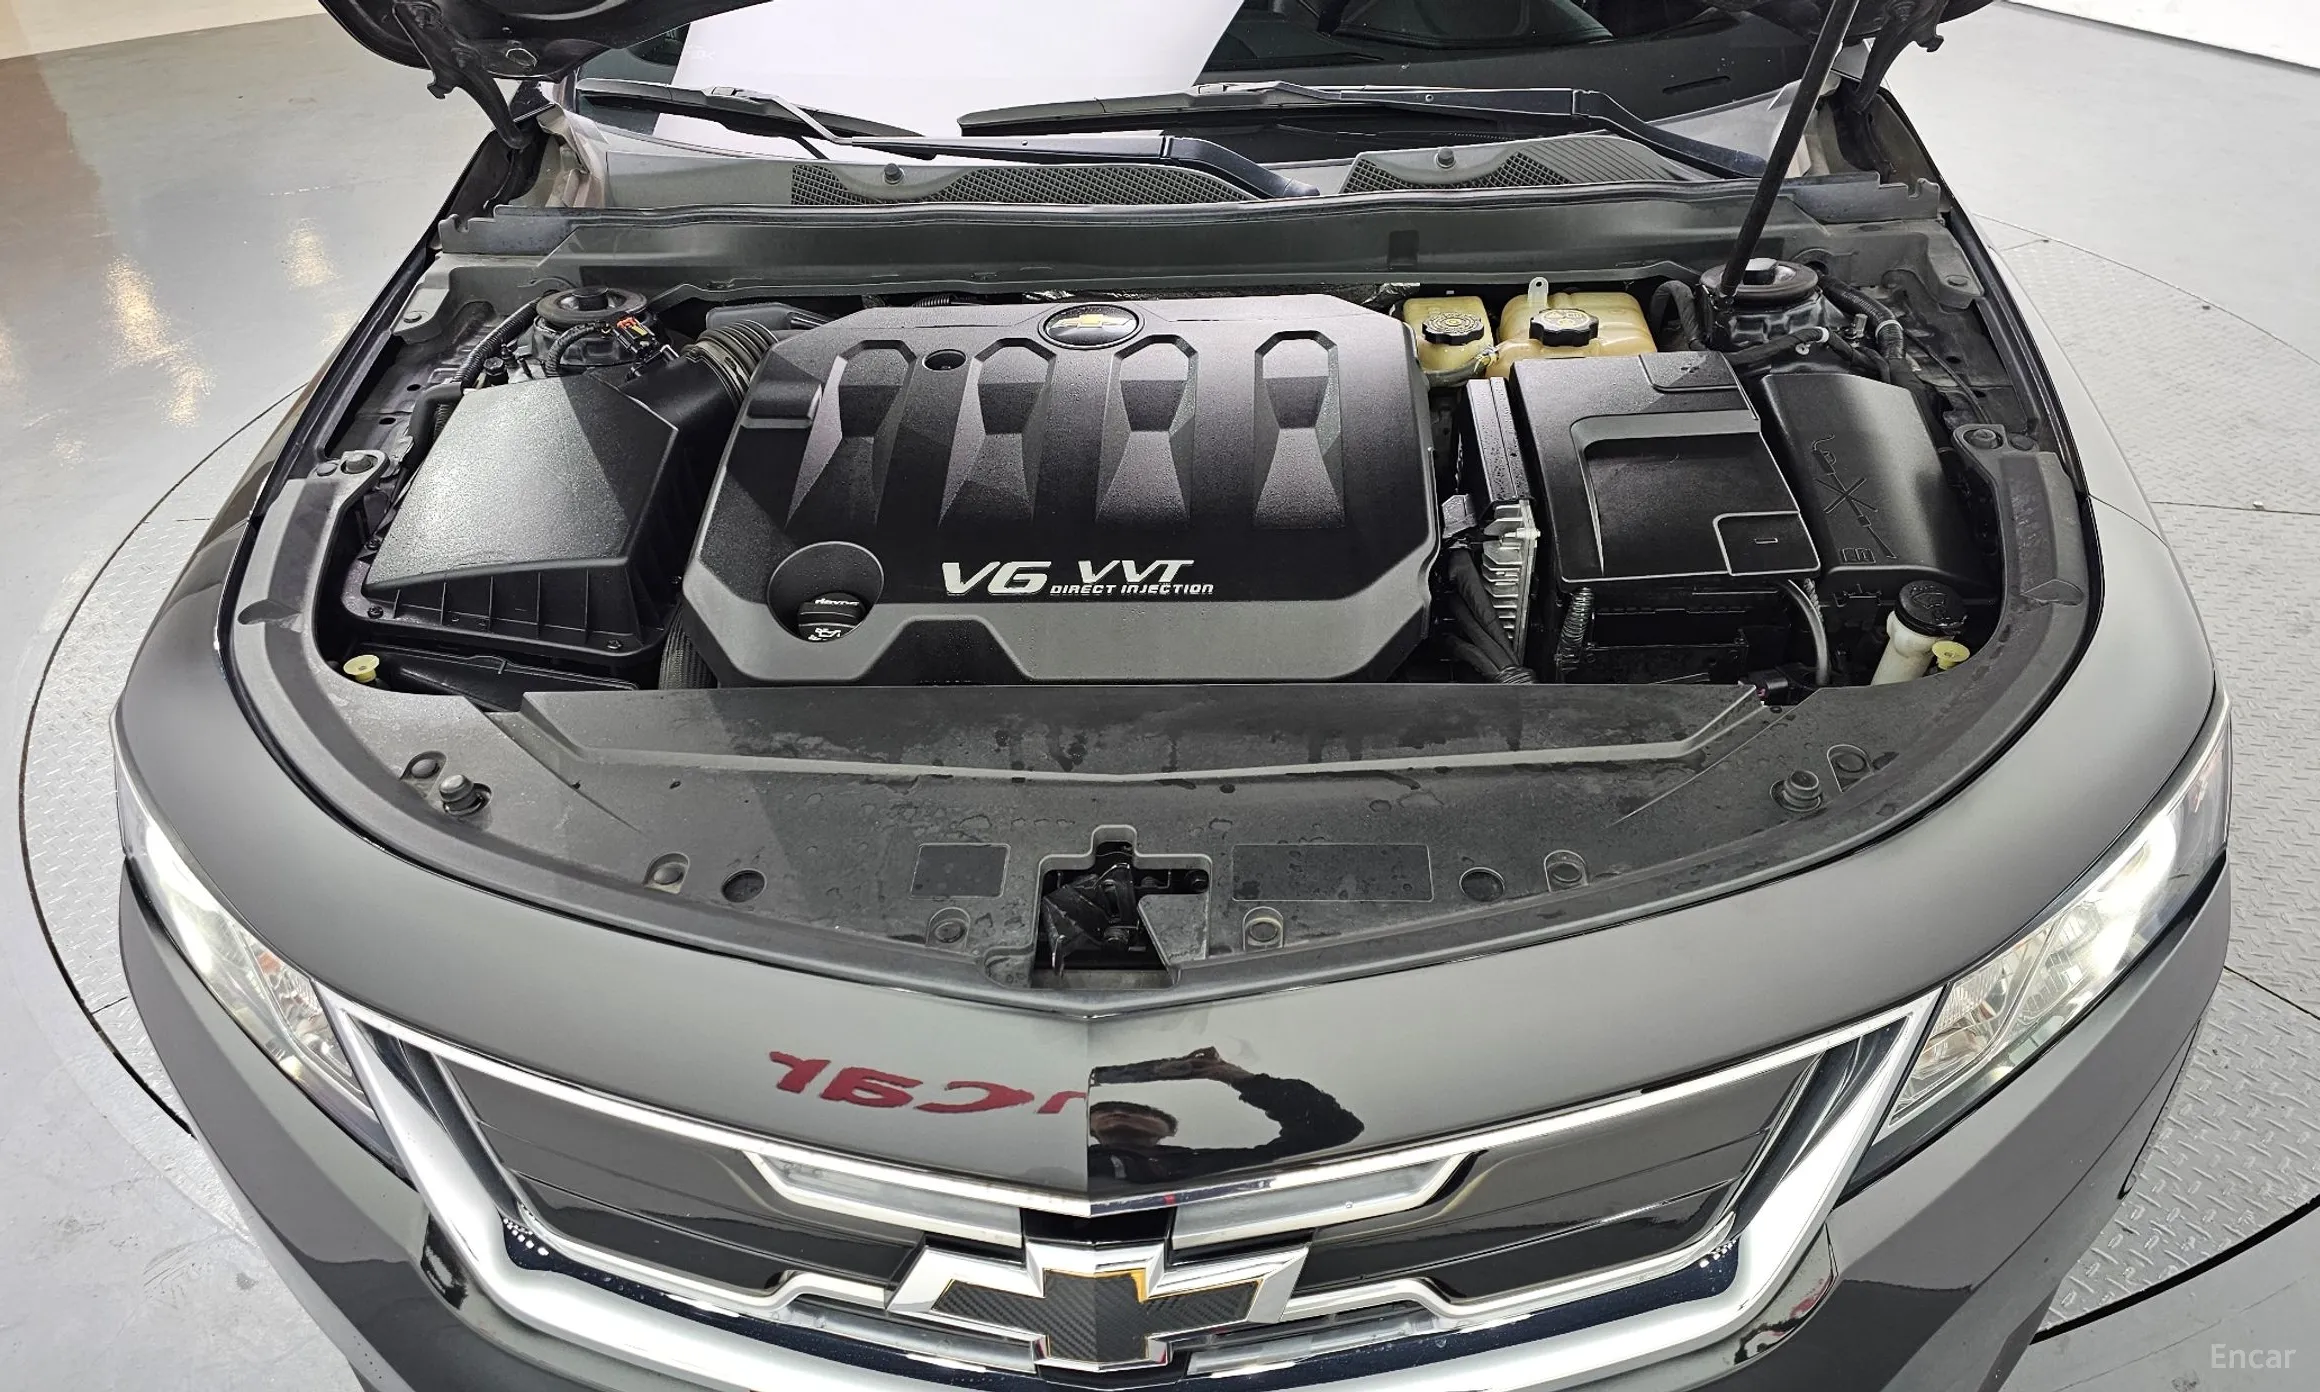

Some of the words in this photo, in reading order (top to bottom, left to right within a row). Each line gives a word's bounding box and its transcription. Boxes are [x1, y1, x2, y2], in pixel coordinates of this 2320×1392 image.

[942, 561, 1051, 595] V6
[1078, 560, 1195, 583] VVT
[1050, 584, 1117, 595] DIRECT
[1121, 583, 1214, 595] INJECTION
